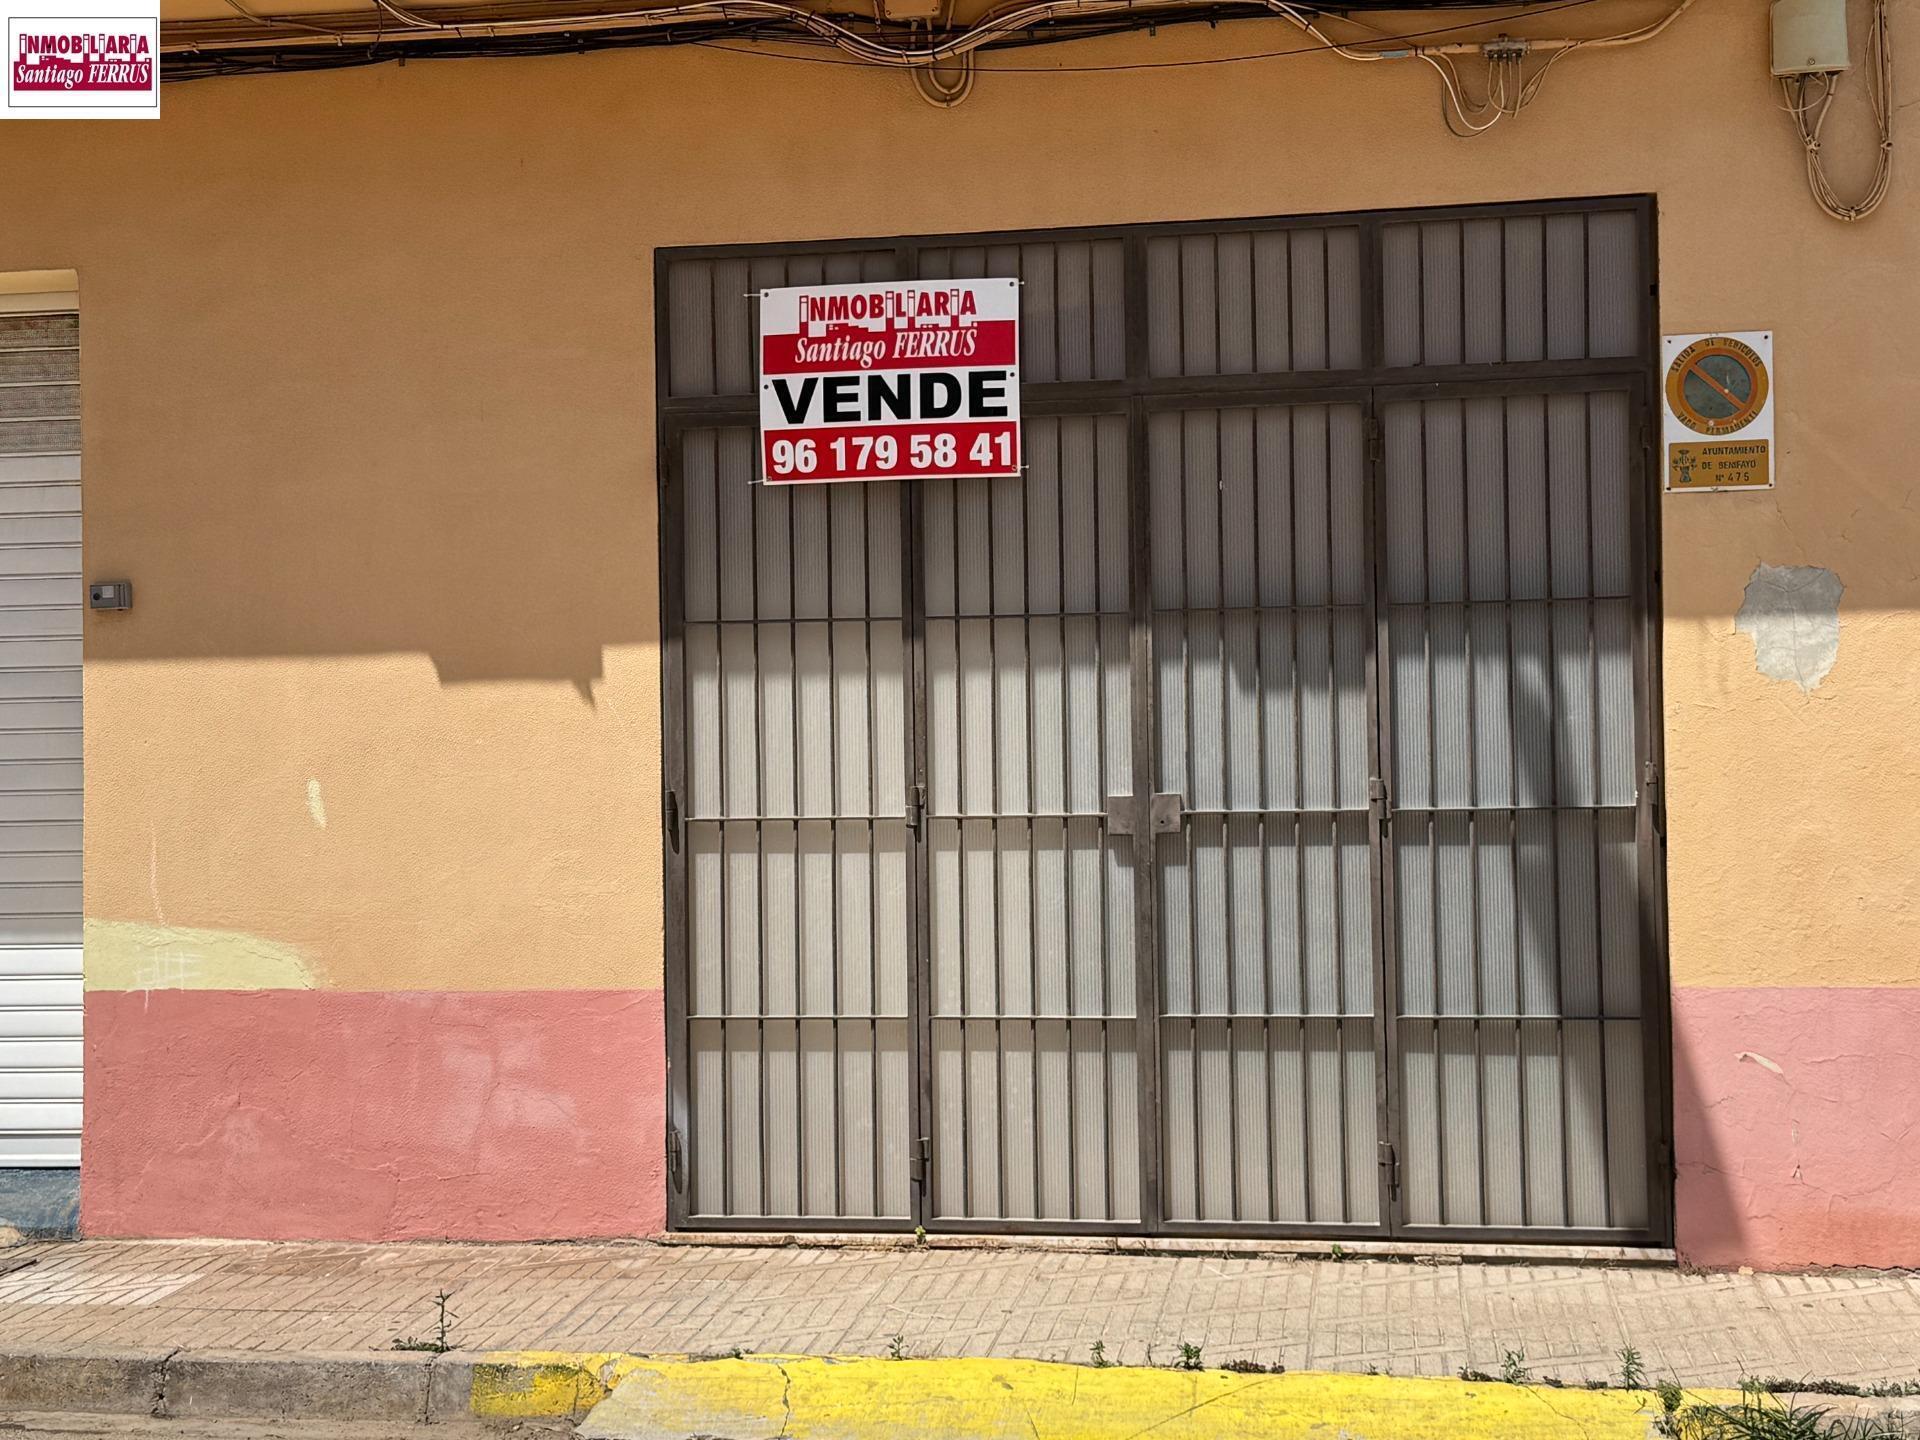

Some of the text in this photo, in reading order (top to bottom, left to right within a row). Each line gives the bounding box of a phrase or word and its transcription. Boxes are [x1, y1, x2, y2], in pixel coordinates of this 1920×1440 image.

[794, 329, 978, 368] Santiago FERRUS
[1671, 345, 1696, 372] SALIDA
[771, 370, 1008, 424] VENDE
[1677, 410, 1697, 429] VADO
[771, 431, 1012, 474] 96 179 58 41
[1702, 445, 1766, 455] AYUNTAMIENTO
[1701, 461, 1713, 470] DE
